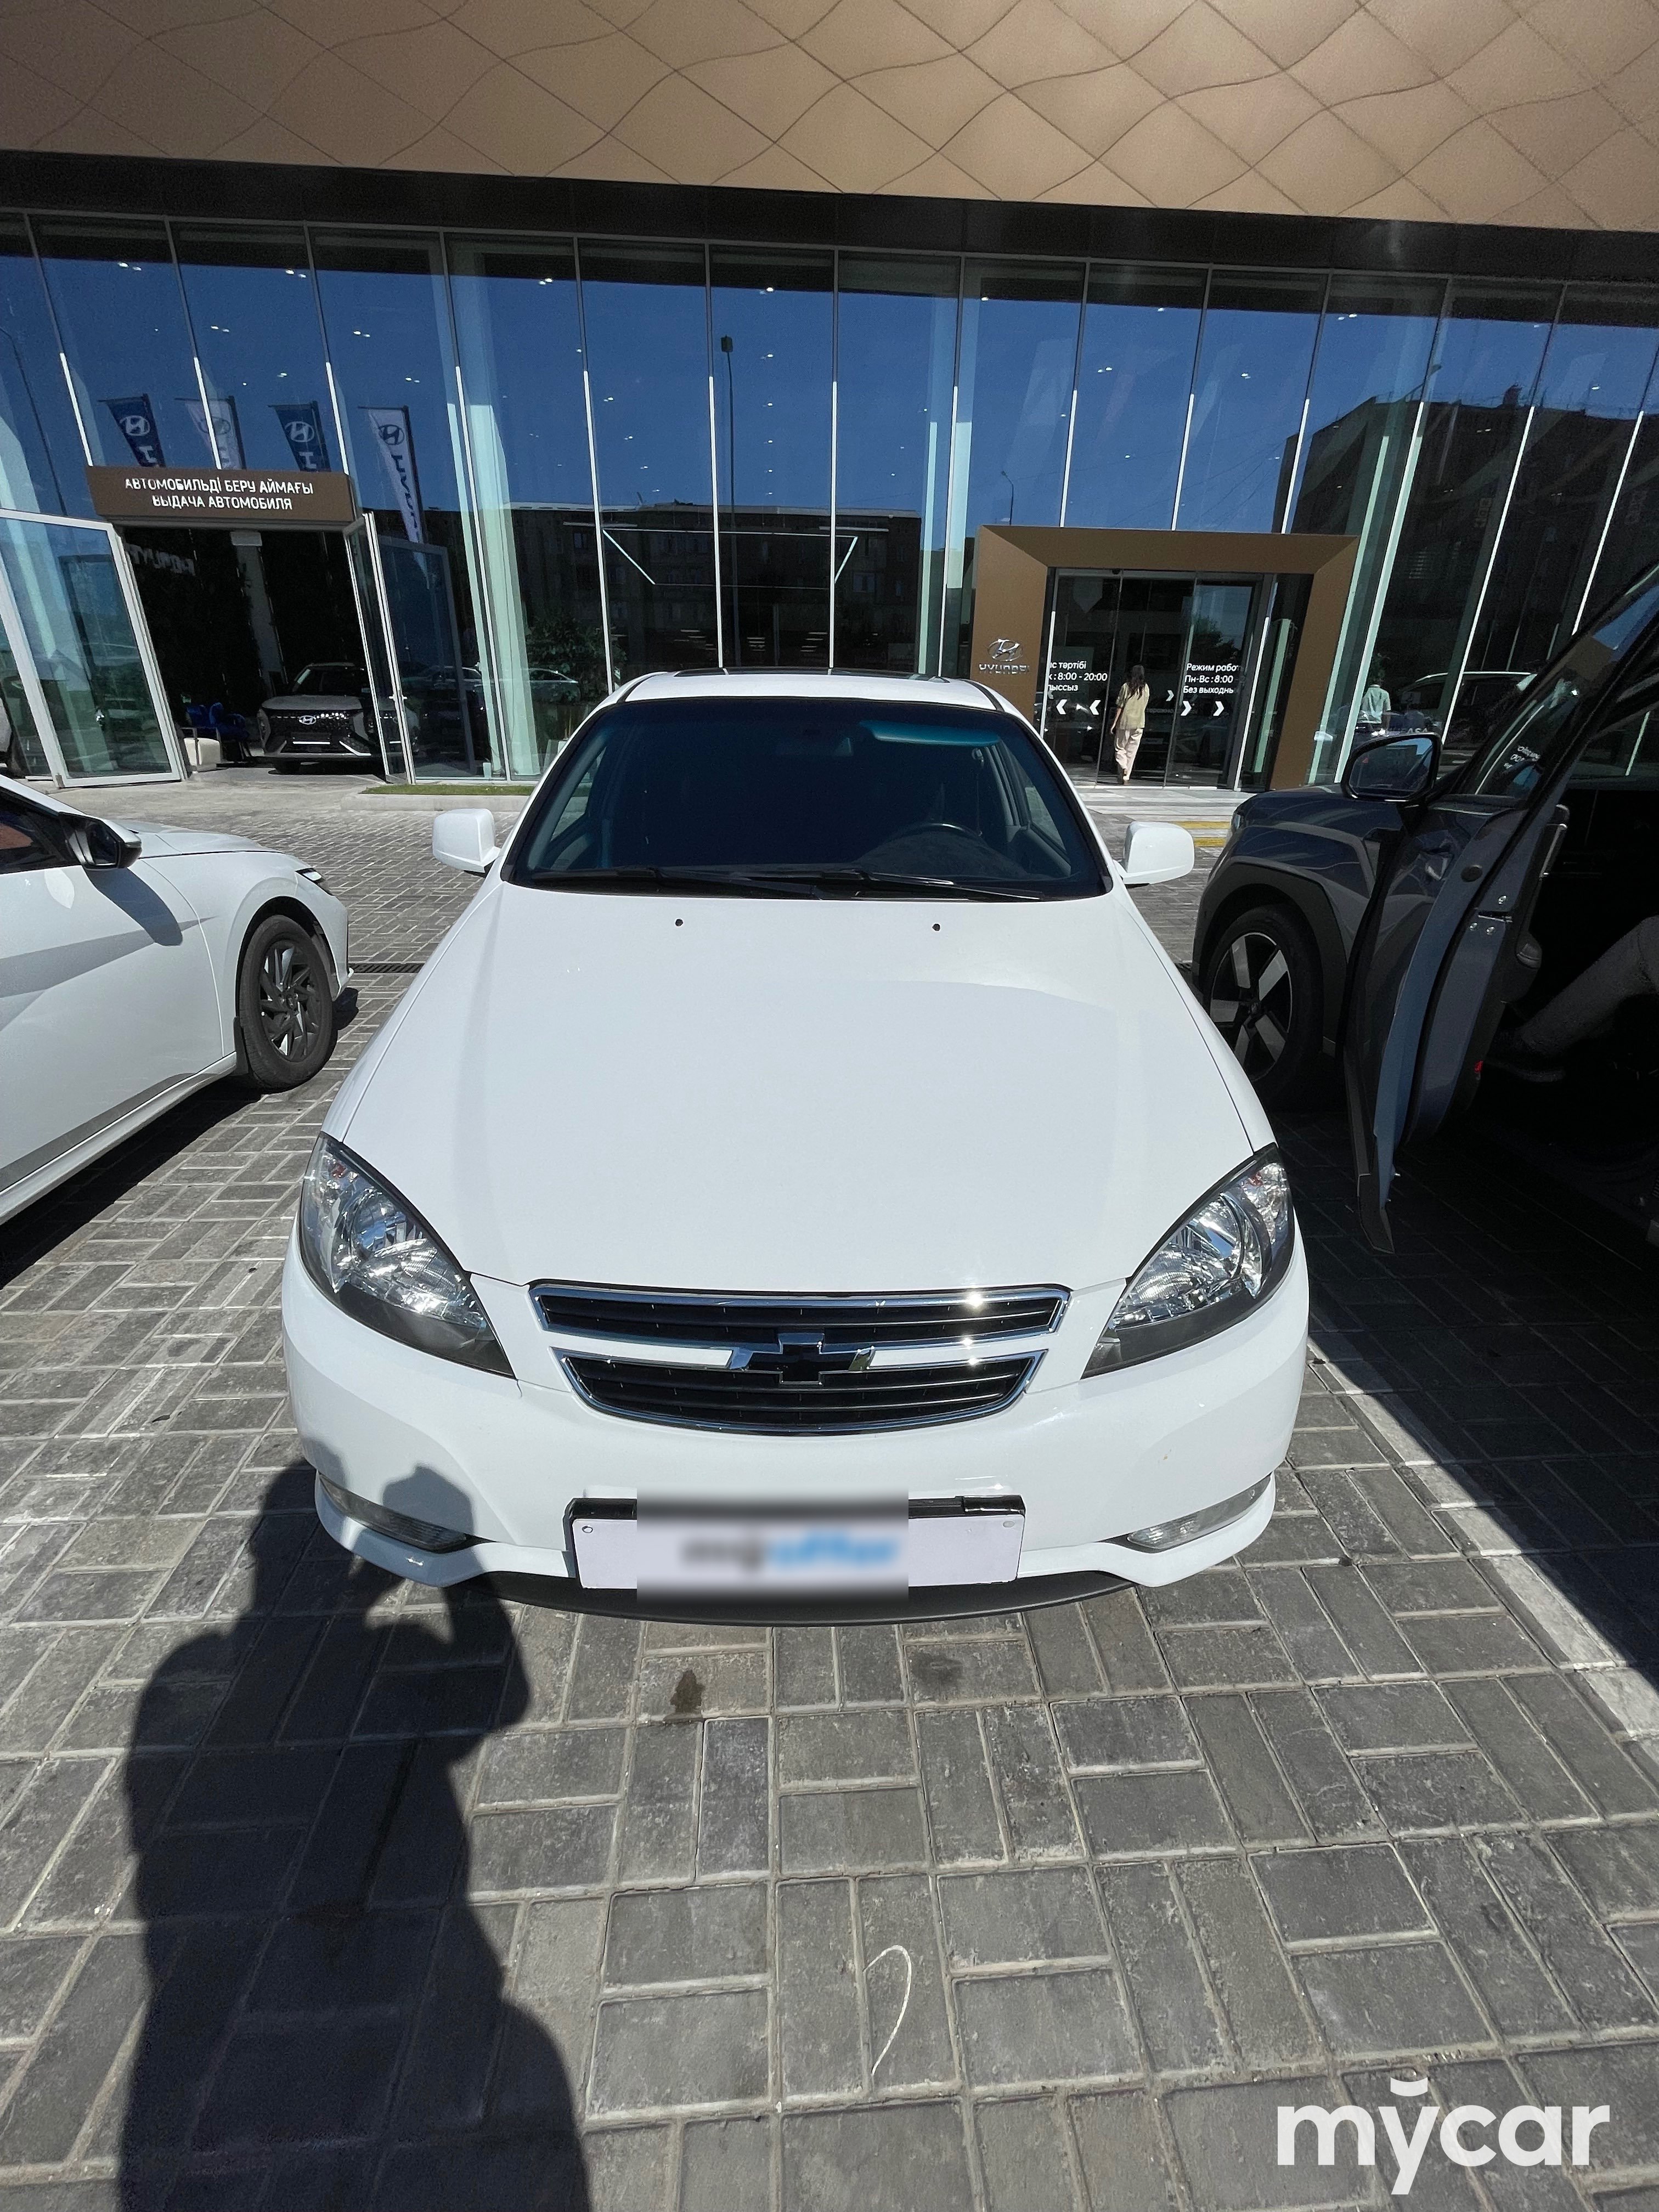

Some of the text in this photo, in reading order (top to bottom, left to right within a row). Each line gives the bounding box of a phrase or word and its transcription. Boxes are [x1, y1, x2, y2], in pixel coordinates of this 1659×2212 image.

[126, 477, 313, 494] АВТОМОБИЛЬДІ БЕРУ АЙМАҒЫ
[153, 495, 292, 510] ВЫДАЧА АВТОМОБИЛЯ
[1187, 663, 1214, 671] Режим
